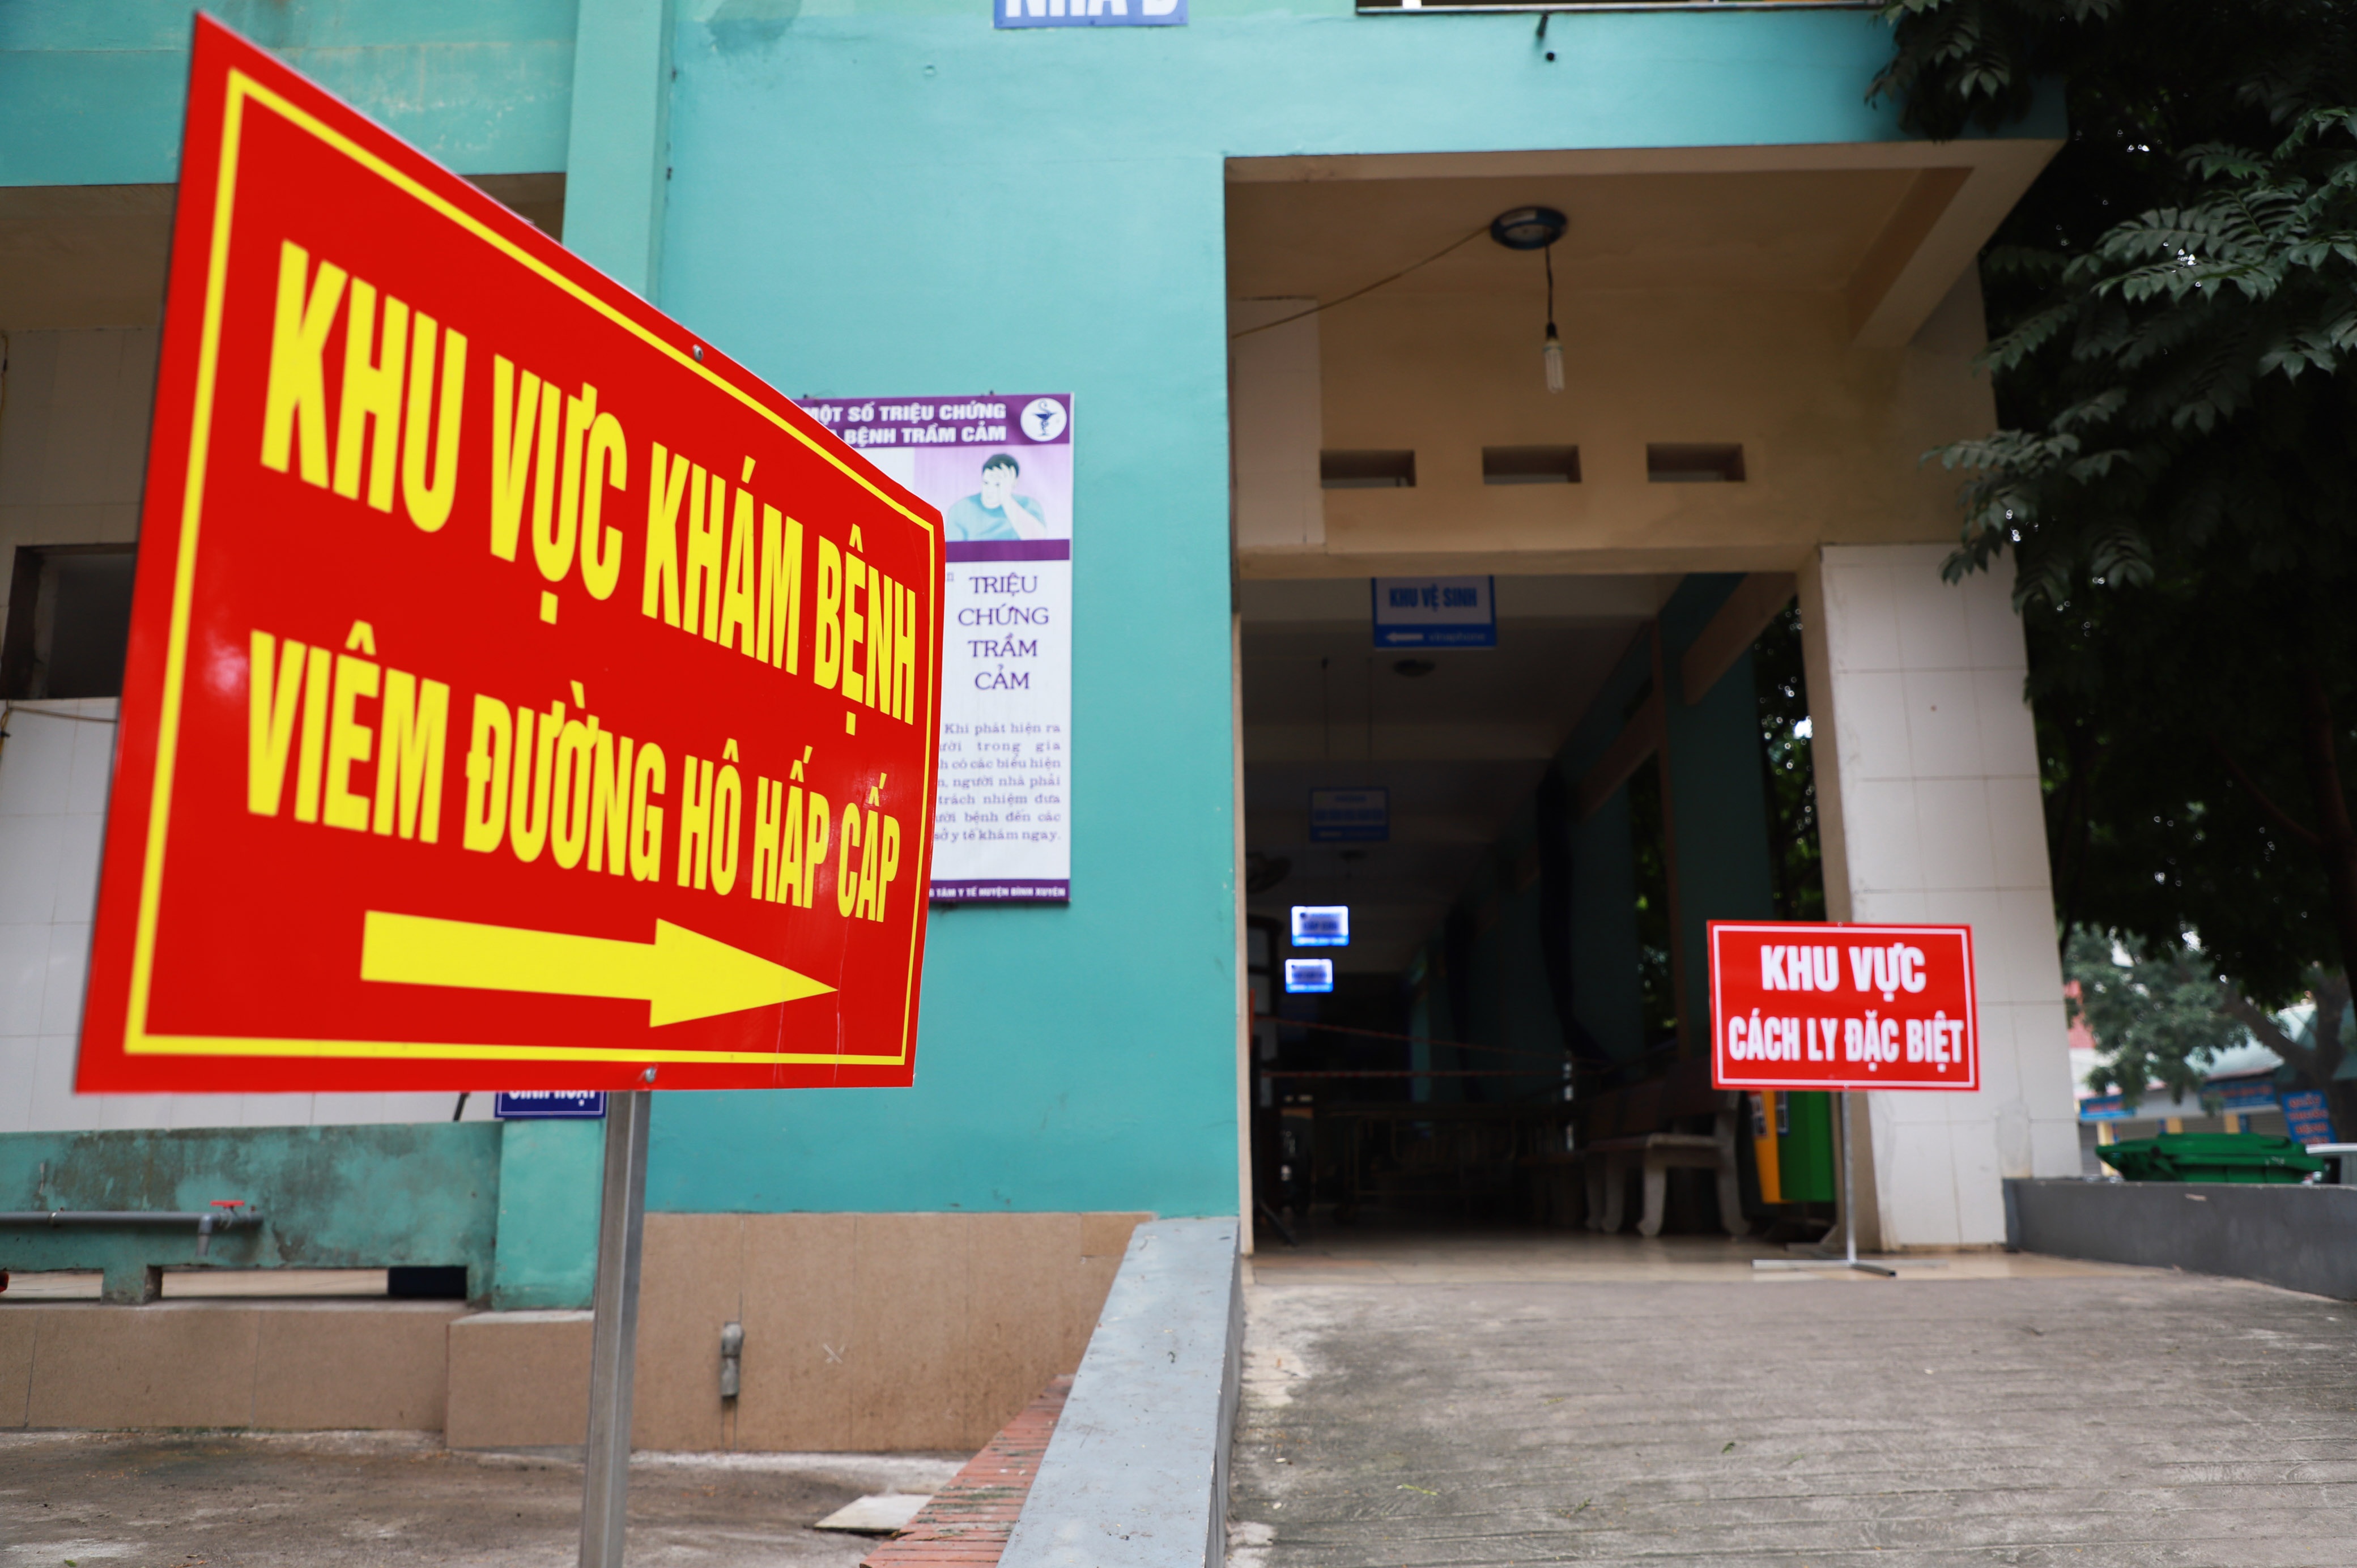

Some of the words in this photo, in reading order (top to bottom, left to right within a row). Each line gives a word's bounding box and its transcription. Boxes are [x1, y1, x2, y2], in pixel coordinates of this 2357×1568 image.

[848, 401, 875, 422] SỐ
[879, 402, 934, 424] TRIỆU
[939, 400, 1006, 420] CHỨNG
[844, 426, 896, 447] BỆNH
[961, 420, 1006, 442] CẢM
[261, 238, 467, 532] KHU
[490, 353, 627, 625] VỰC
[642, 441, 803, 676] KHÁM
[814, 523, 916, 736] BỆNH
[969, 572, 1037, 596] TRIỆU
[1389, 587, 1418, 607] KHU
[958, 603, 1049, 626] CHỨNG
[975, 664, 1029, 690] CẢM
[248, 619, 450, 844] VIÊM
[463, 680, 666, 882] ĐƯỜNG
[677, 738, 741, 896] HÔ
[751, 745, 829, 909] HẤP
[837, 772, 900, 923] CẤP
[1760, 945, 1840, 991] KHU
[1848, 942, 1926, 1002] VỰC
[1728, 1008, 1801, 1061] CÁCH
[1806, 1018, 1838, 1061] LY
[1844, 1009, 1899, 1072] ĐẶC
[1906, 1010, 1964, 1072] BIỆT
